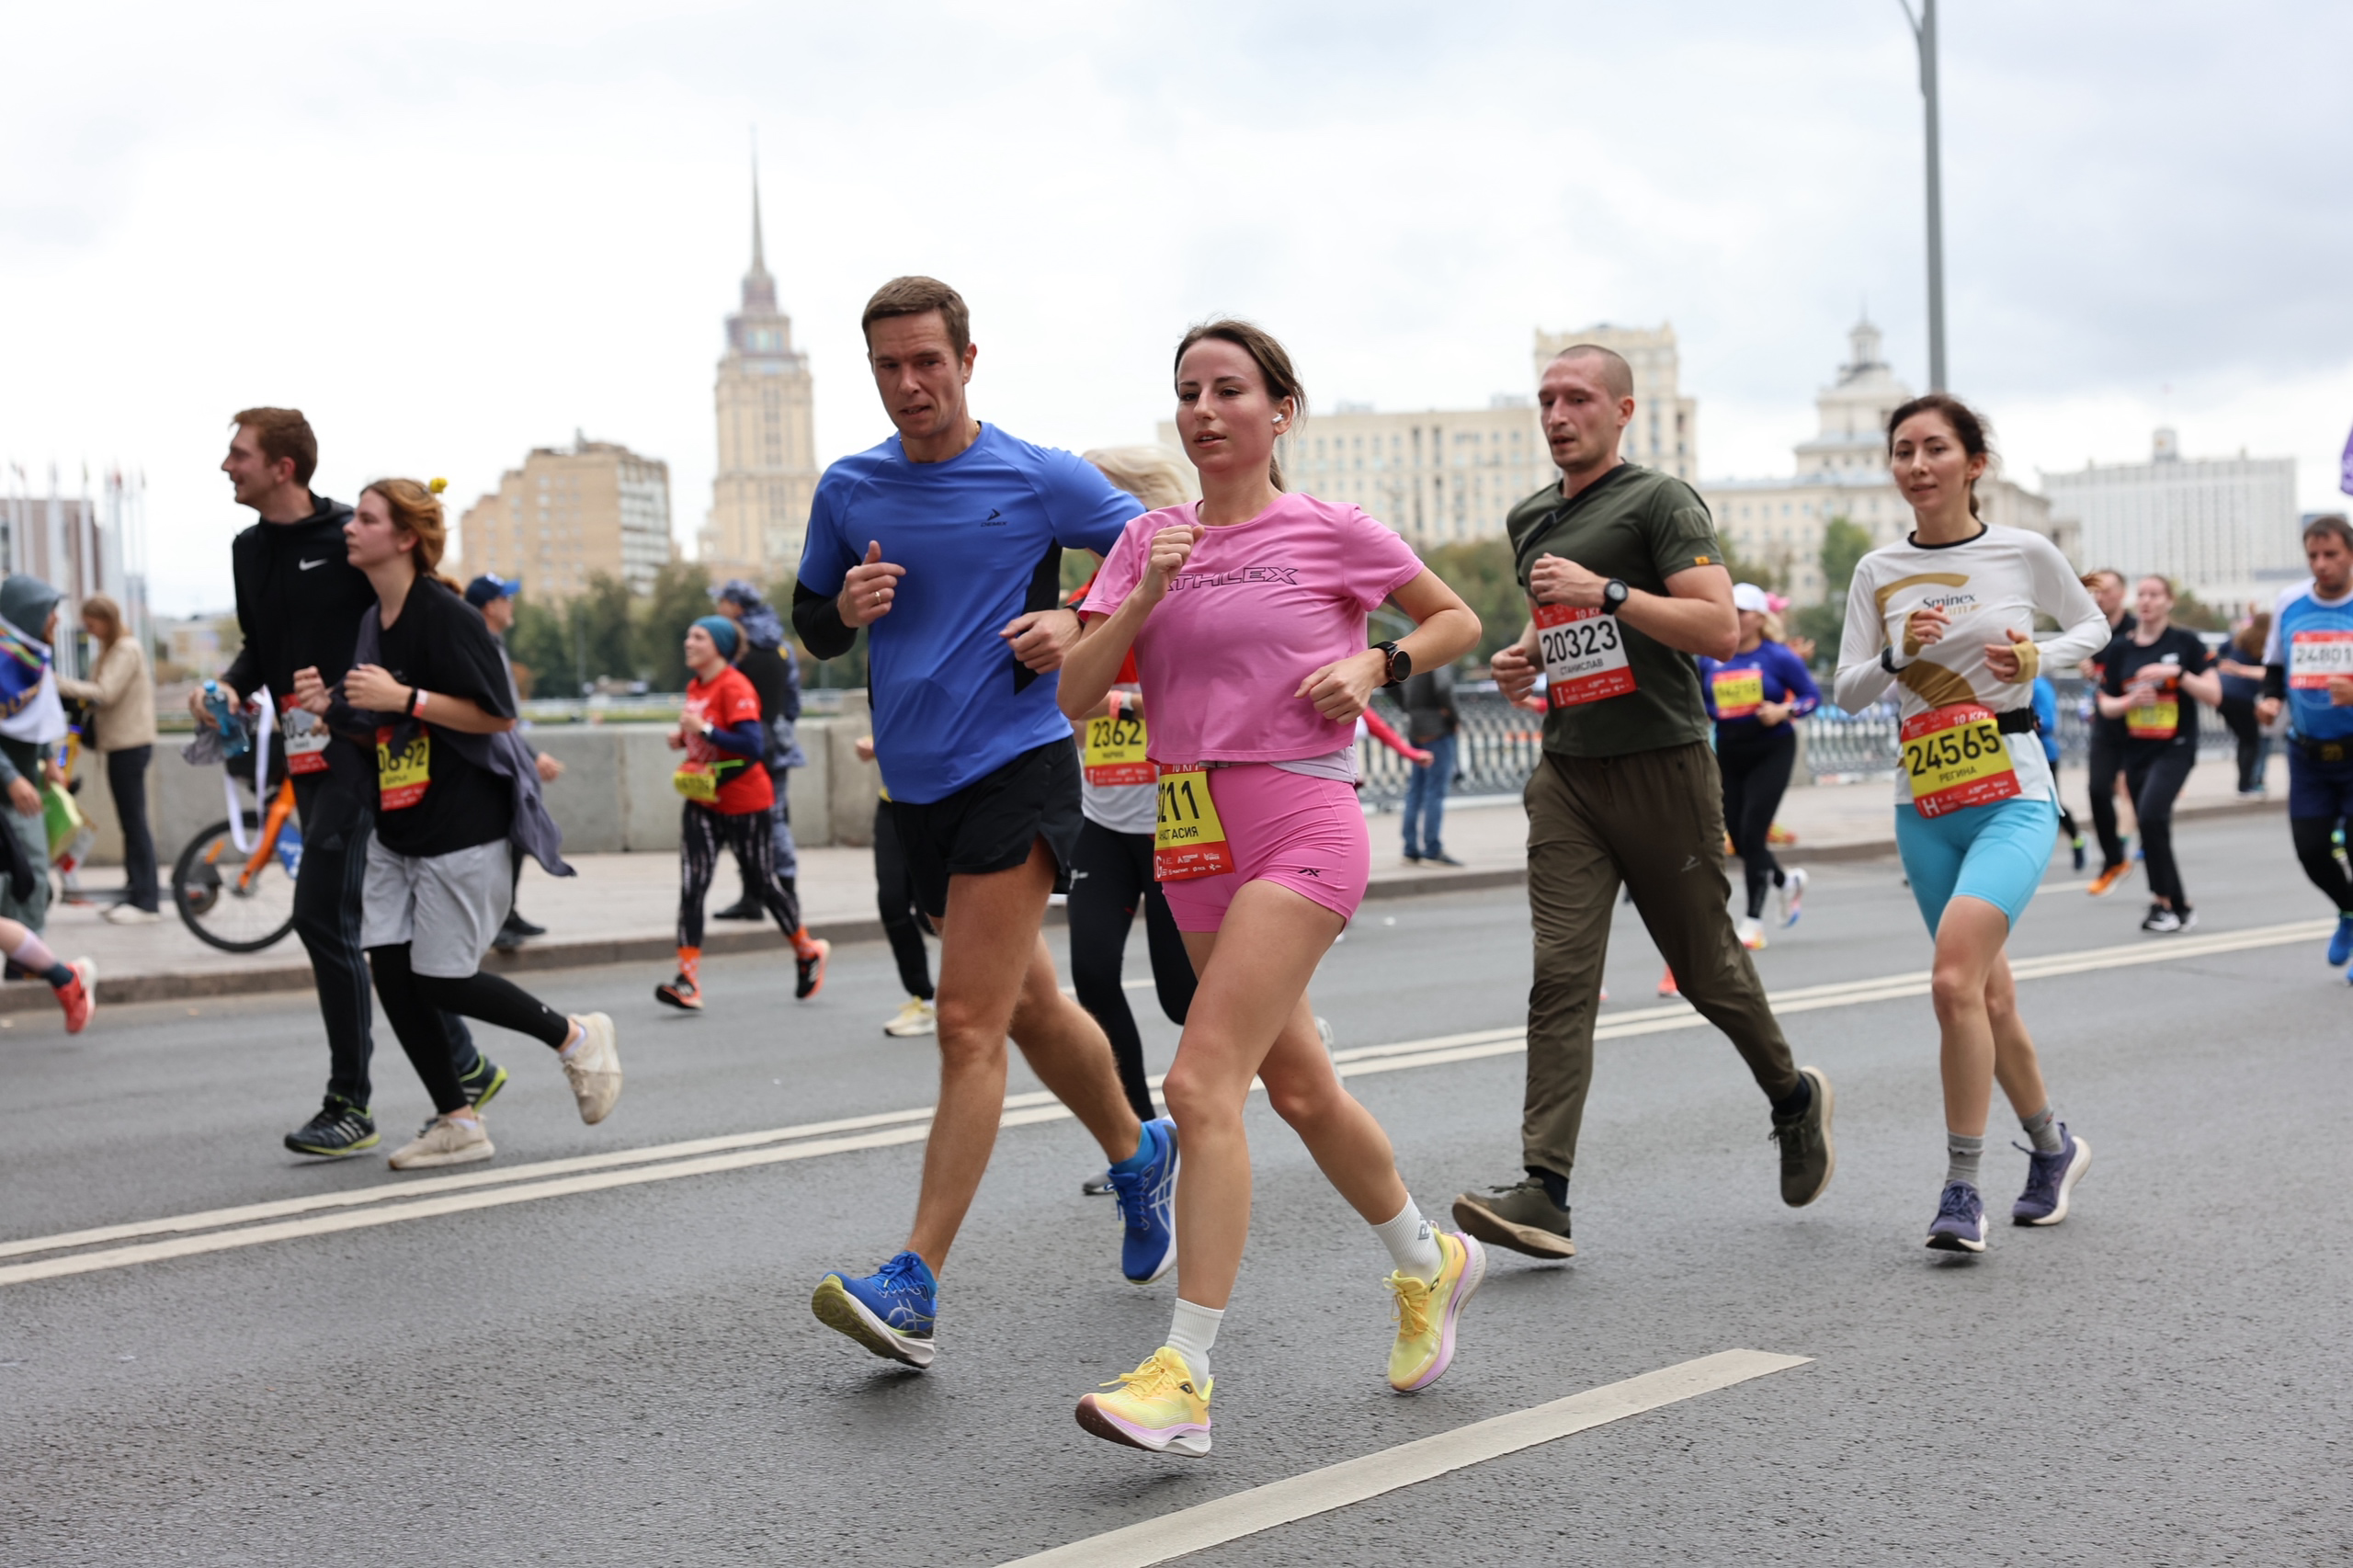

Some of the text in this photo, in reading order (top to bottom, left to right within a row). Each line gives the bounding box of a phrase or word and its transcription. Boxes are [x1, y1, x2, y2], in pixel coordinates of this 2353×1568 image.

[1923, 594, 1976, 608] Sminex
[1542, 619, 1618, 665] 20323
[1560, 658, 1604, 676] СТАНИСЛАВ
[1953, 712, 1967, 726] 10
[1093, 720, 1142, 748] 2362
[1907, 724, 2000, 777] 24565
[1939, 767, 1977, 783] РЕГИНА
